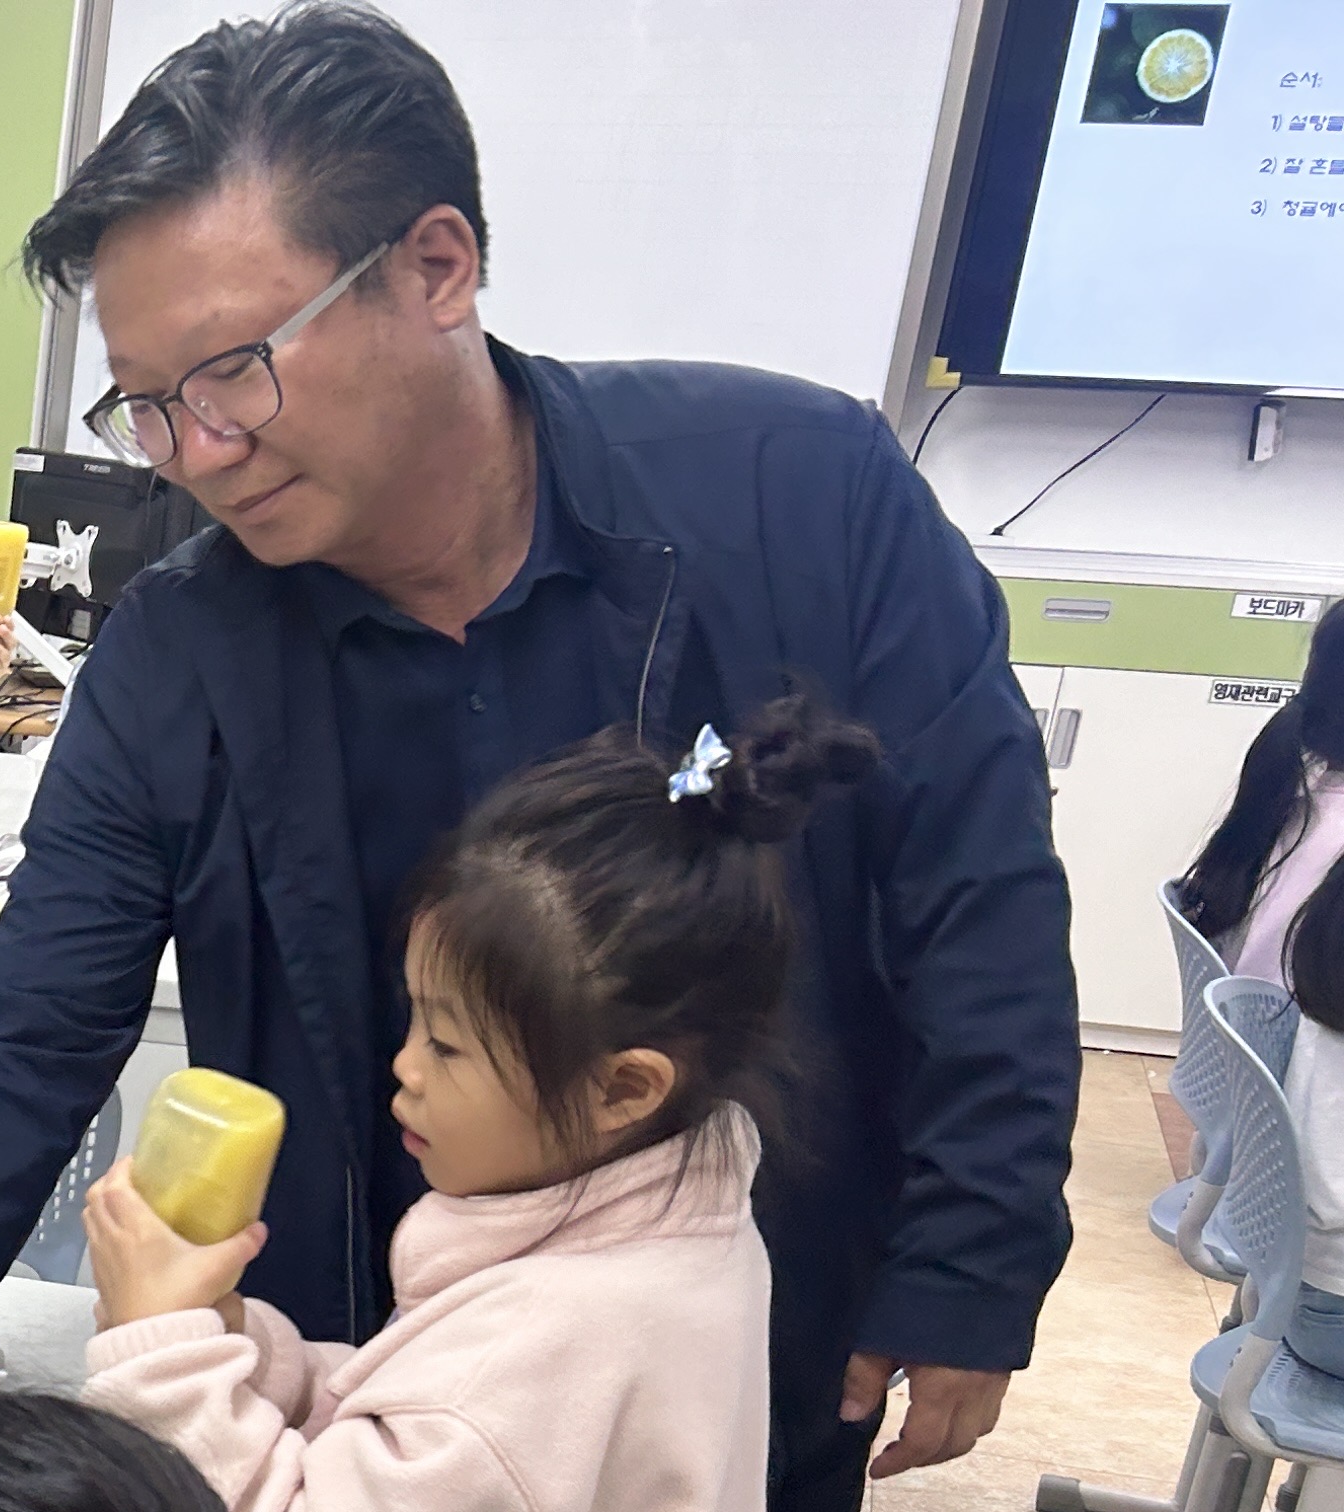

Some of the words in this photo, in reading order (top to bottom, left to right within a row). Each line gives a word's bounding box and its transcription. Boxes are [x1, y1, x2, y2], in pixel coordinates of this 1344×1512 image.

[1271, 114, 1283, 132] 1)
[1259, 157, 1278, 175] 2)
[1250, 199, 1268, 217] 3)
[1247, 598, 1305, 618] 보드마카
